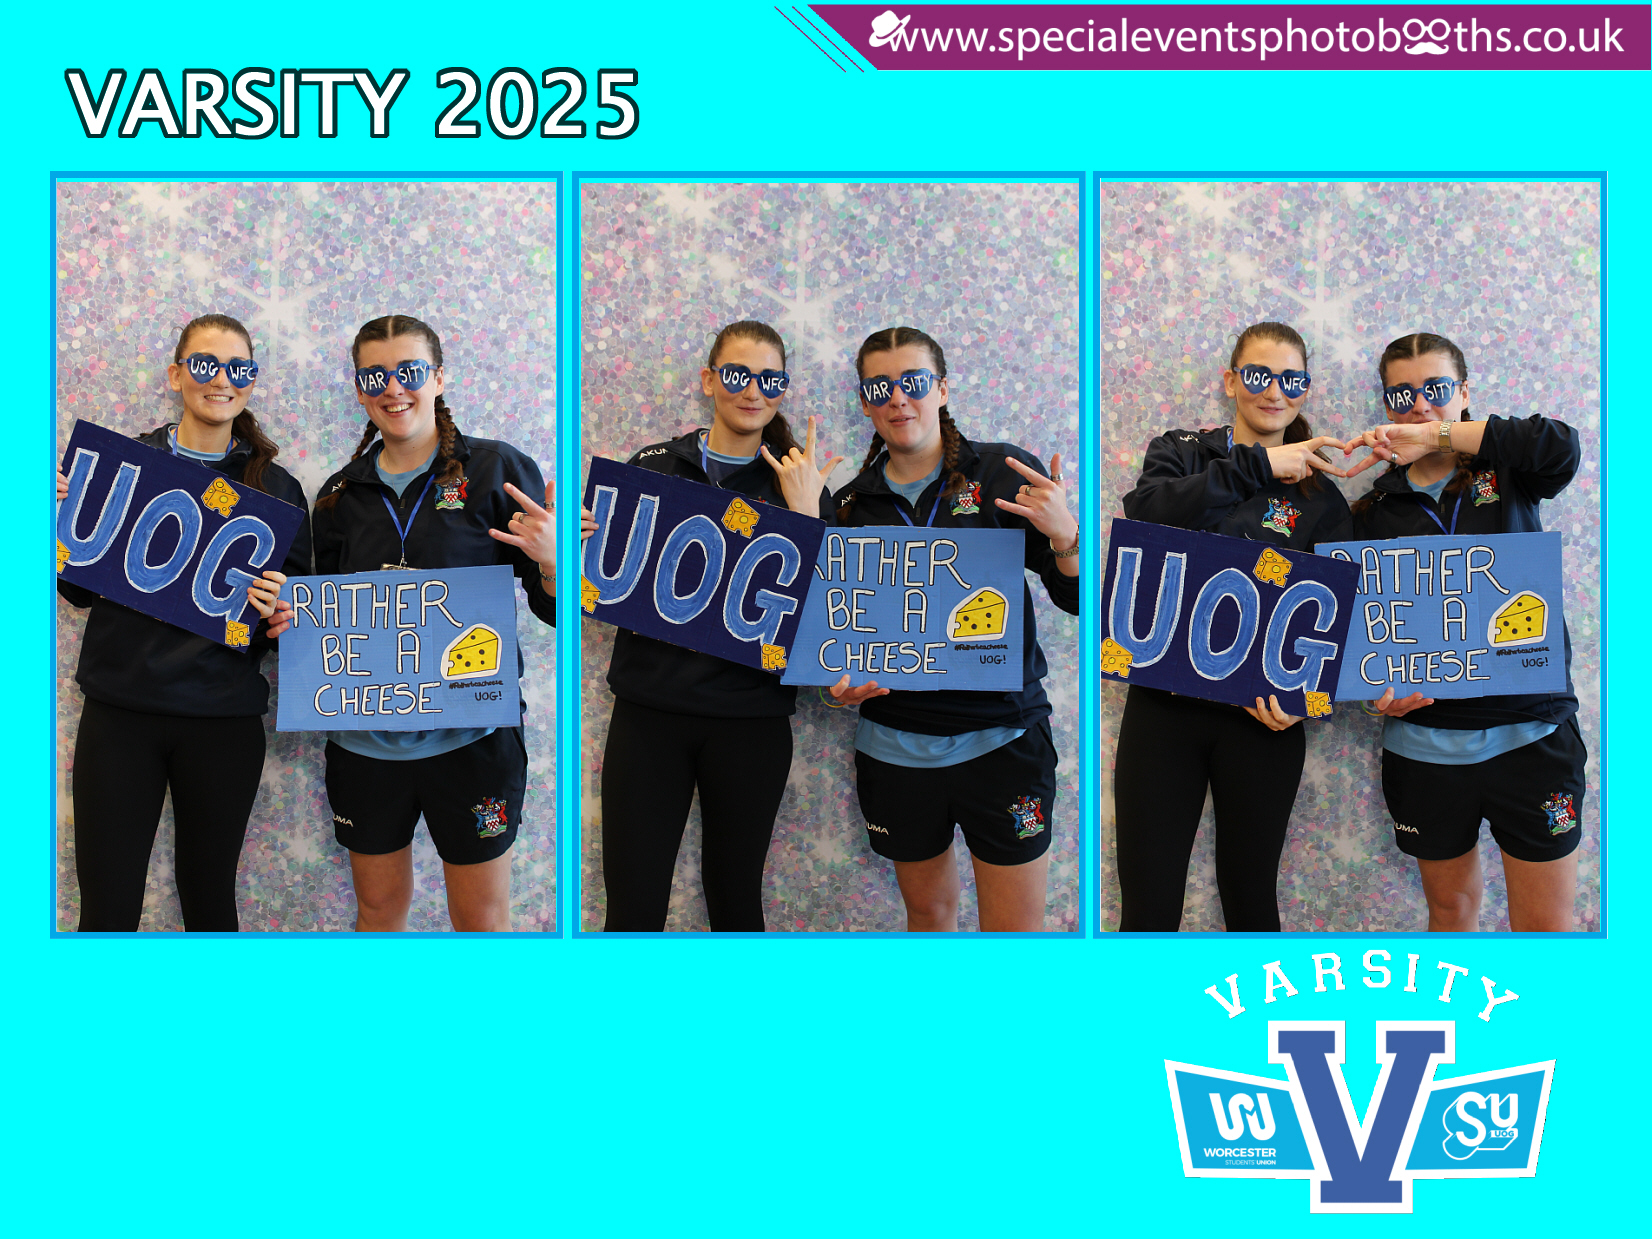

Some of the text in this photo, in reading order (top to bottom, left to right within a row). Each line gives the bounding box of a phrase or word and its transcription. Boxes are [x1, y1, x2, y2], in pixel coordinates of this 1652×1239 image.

[190, 358, 255, 380] UOG WFC
[722, 368, 786, 391] UOG WFC
[1243, 369, 1308, 391] UOG WFC
[57, 447, 276, 621] UOG
[581, 484, 801, 646] UOG
[814, 532, 972, 590] ATHER
[292, 580, 463, 629] RATHER
[828, 588, 927, 634] BE A
[1108, 546, 1339, 692] UOG
[1364, 598, 1467, 644] BE A
[321, 631, 421, 676] BE A
[817, 640, 948, 675] CHEESE
[979, 654, 1006, 665] UOG!
[1360, 649, 1491, 686] CHEESE
[1521, 656, 1549, 668] UOG!
[314, 681, 444, 717] CHEESE
[474, 690, 502, 701] UOG!
[866, 822, 889, 836] UMA
[1394, 821, 1420, 835] UMA
